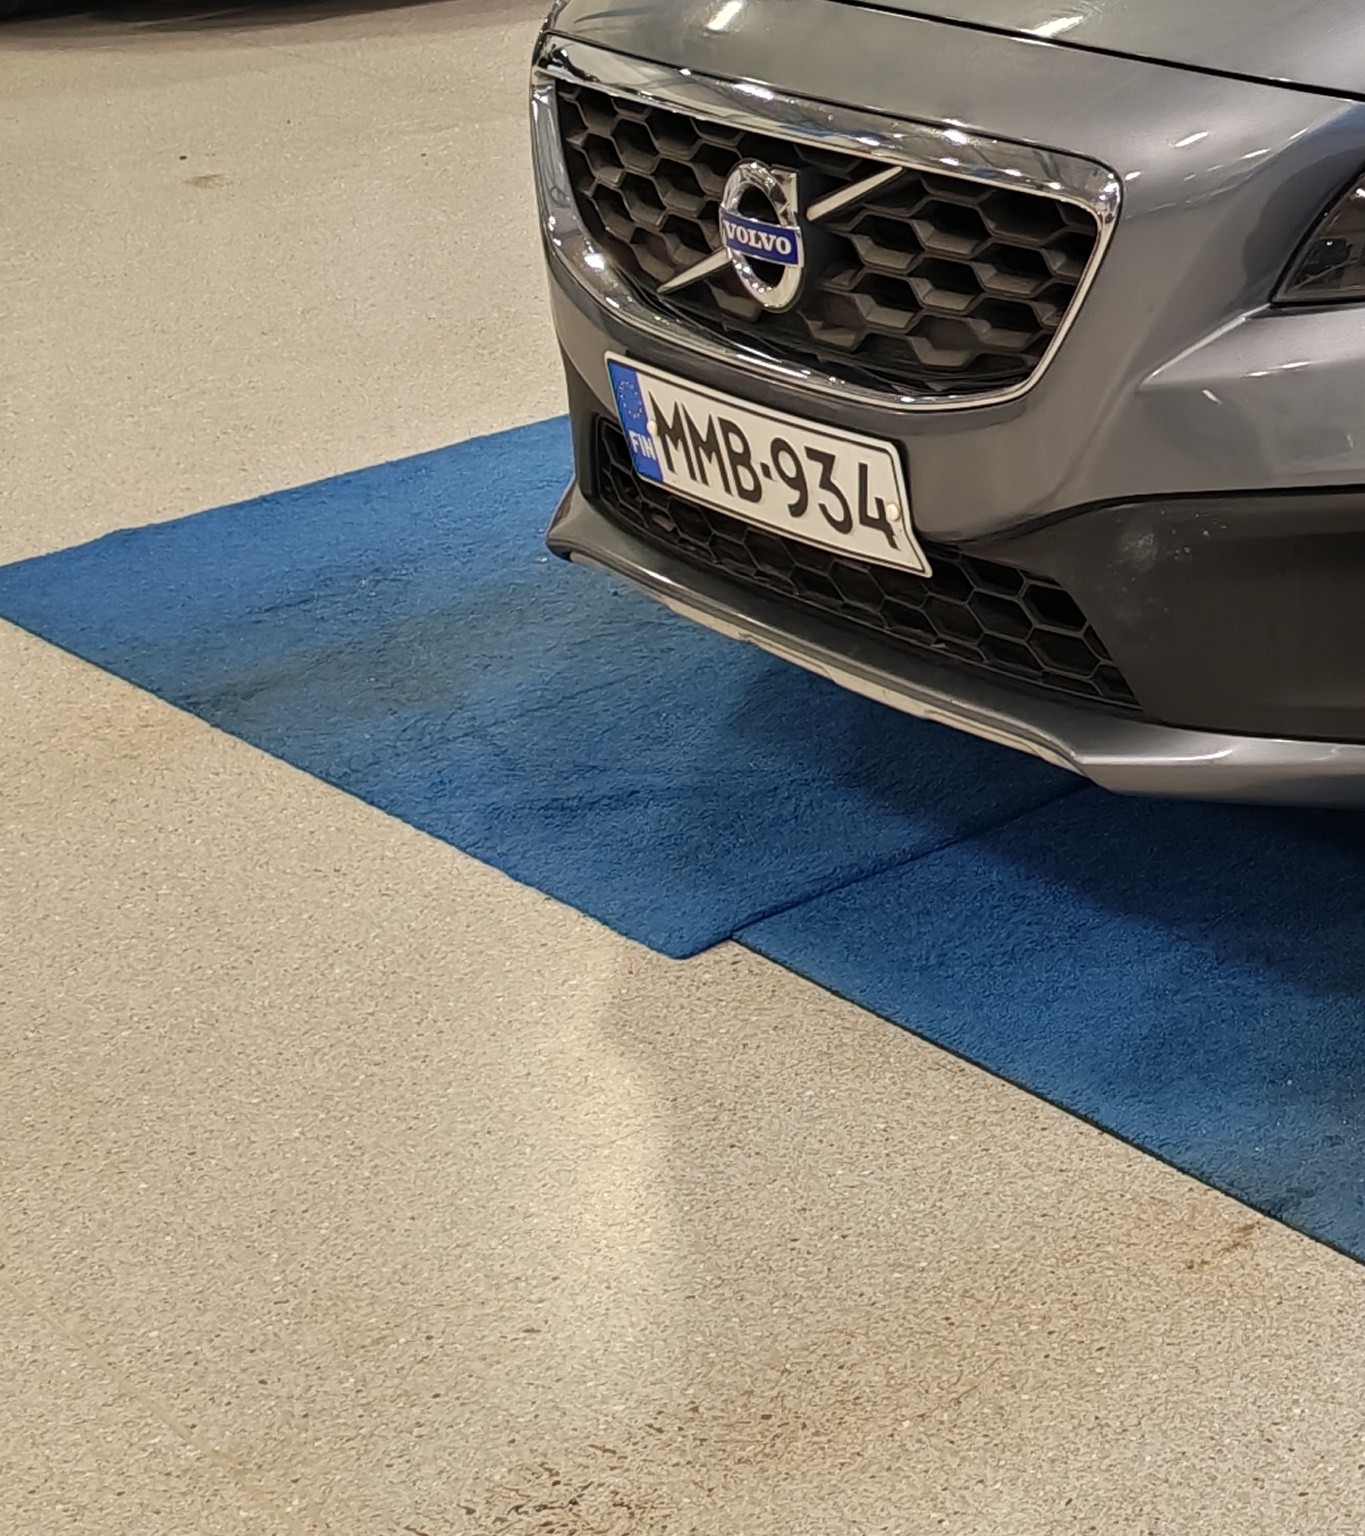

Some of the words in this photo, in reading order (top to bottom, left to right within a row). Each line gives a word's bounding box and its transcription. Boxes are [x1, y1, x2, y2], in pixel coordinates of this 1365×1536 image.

[722, 219, 792, 255] VOLVO
[629, 430, 657, 461] FIN
[648, 390, 901, 551] MMB-934
